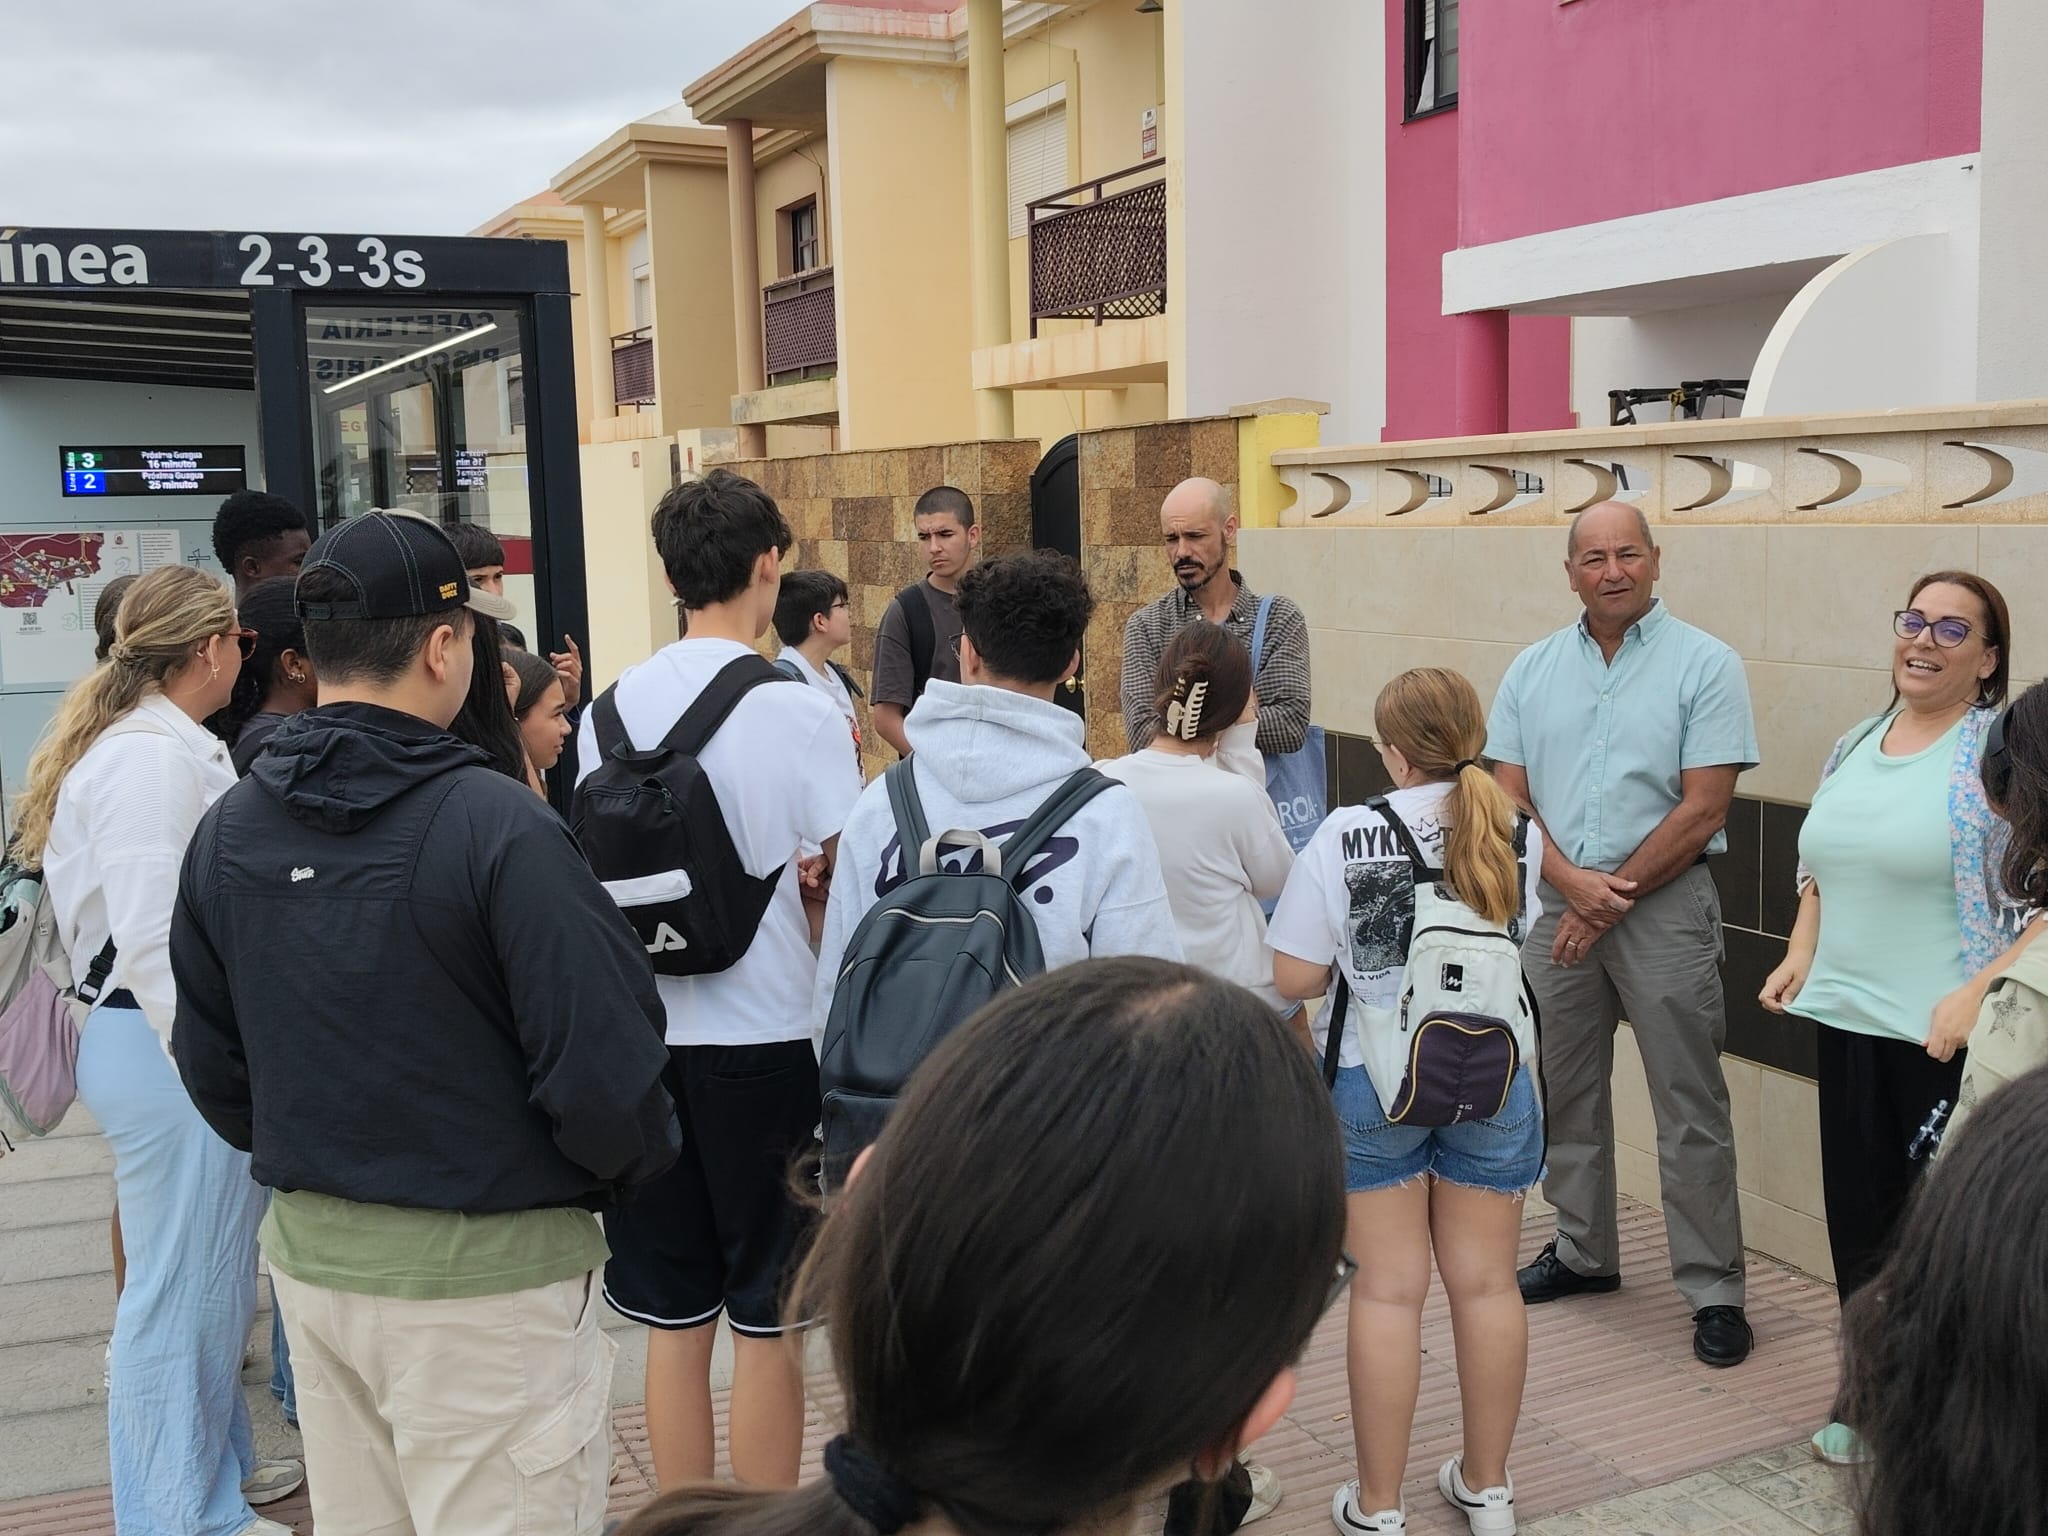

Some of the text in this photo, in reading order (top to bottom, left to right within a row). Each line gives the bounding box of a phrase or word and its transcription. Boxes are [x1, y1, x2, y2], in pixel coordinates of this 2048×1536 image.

[0, 229, 426, 288] ínea 2-3-3s
[81, 453, 96, 469] 3
[148, 460, 197, 468] 16 minutos
[84, 474, 97, 489] 2
[148, 480, 198, 489] 25 minutos
[114, 557, 131, 576] 2
[1353, 970, 1391, 981] LA VIDA
[1488, 1493, 1504, 1501] NIKE
